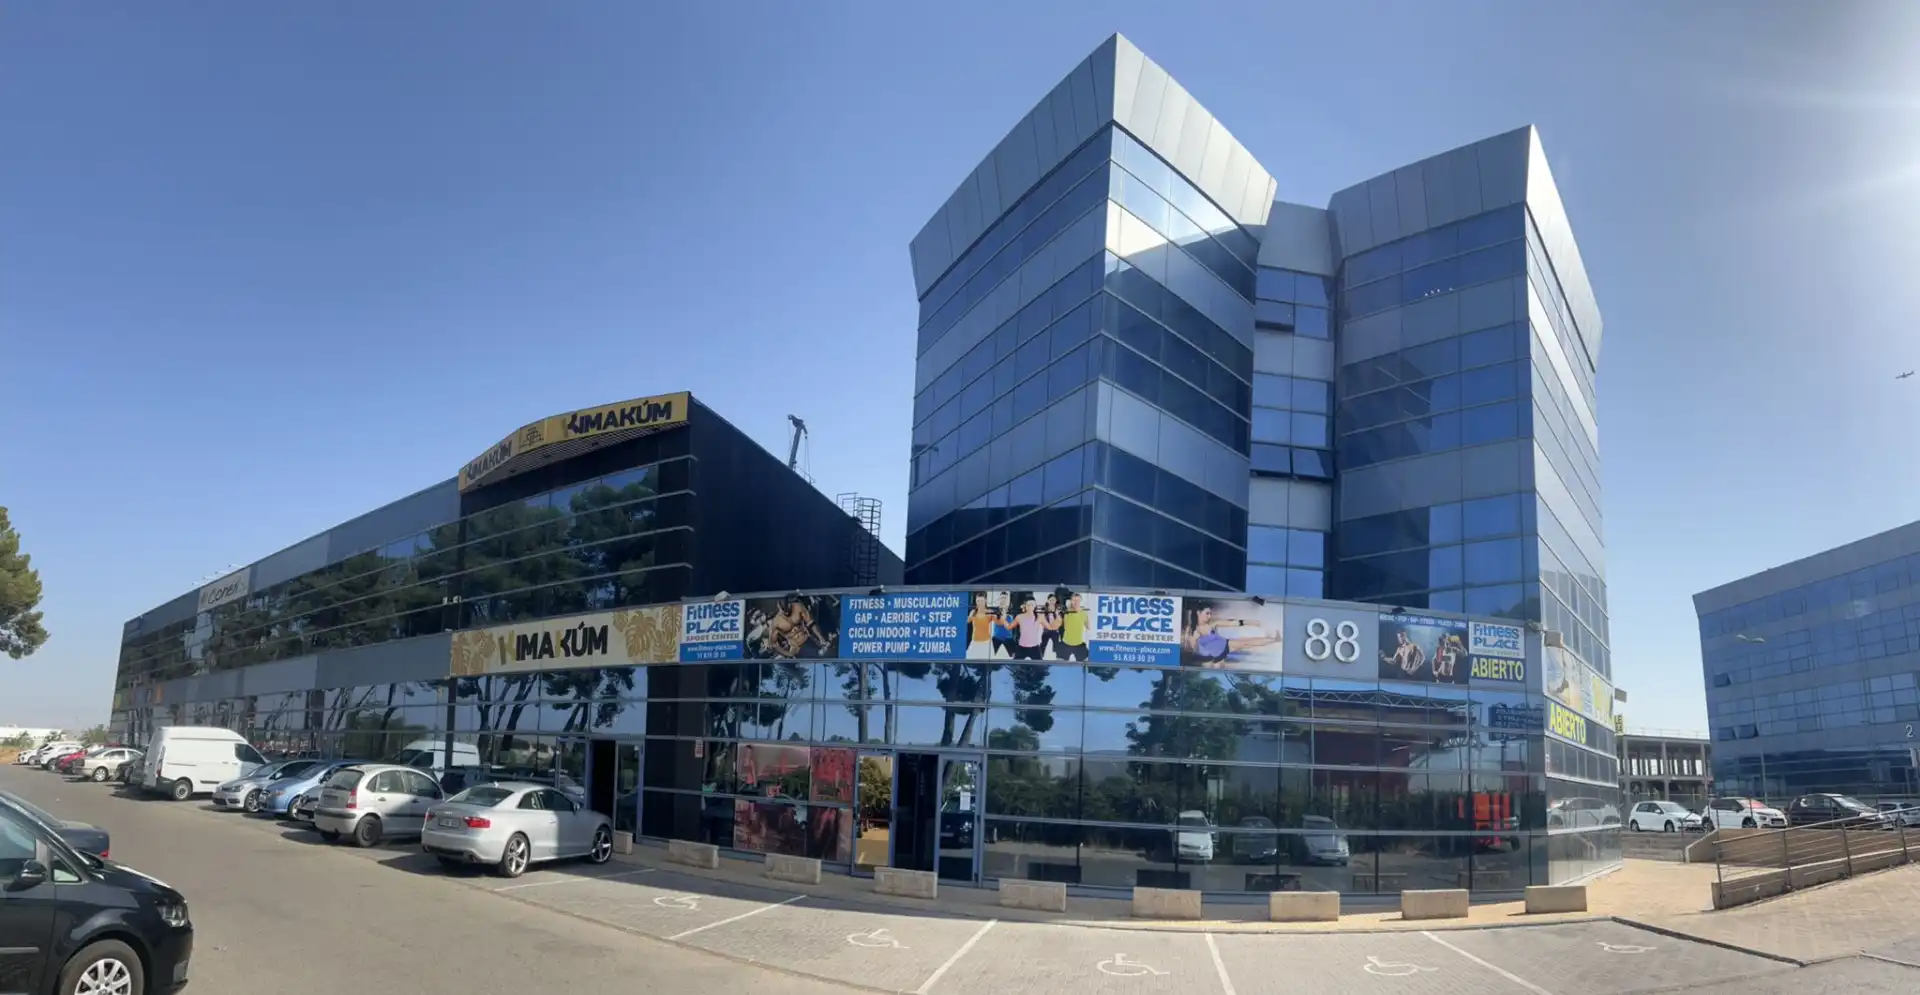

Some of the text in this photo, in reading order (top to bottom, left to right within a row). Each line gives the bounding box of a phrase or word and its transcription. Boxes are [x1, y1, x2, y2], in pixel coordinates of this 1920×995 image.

[564, 399, 672, 438] KIMAKÚM
[849, 594, 960, 610] FITNESS MUSCULACIÓN
[1097, 596, 1174, 616] Fitness
[687, 602, 740, 620] Fitness
[855, 611, 952, 624] GAP AEROBIC STEP
[686, 619, 739, 634] PLACE
[1097, 615, 1174, 632] PLACE
[1473, 623, 1520, 639] Fitness
[848, 626, 957, 638] CICLO INDOOR PILATES
[1096, 632, 1174, 642] SPORT CENTER
[1304, 617, 1361, 663] 88
[498, 621, 608, 665] KIMAKÚM
[852, 641, 951, 653] POWER PUMP ZUMBA
[1098, 644, 1171, 655] www.fitness-place.com
[1473, 637, 1519, 650] PLACE
[1471, 657, 1524, 680] ABIERTO
[1550, 703, 1586, 744] ABIERTO
[1905, 724, 1914, 738] 2
